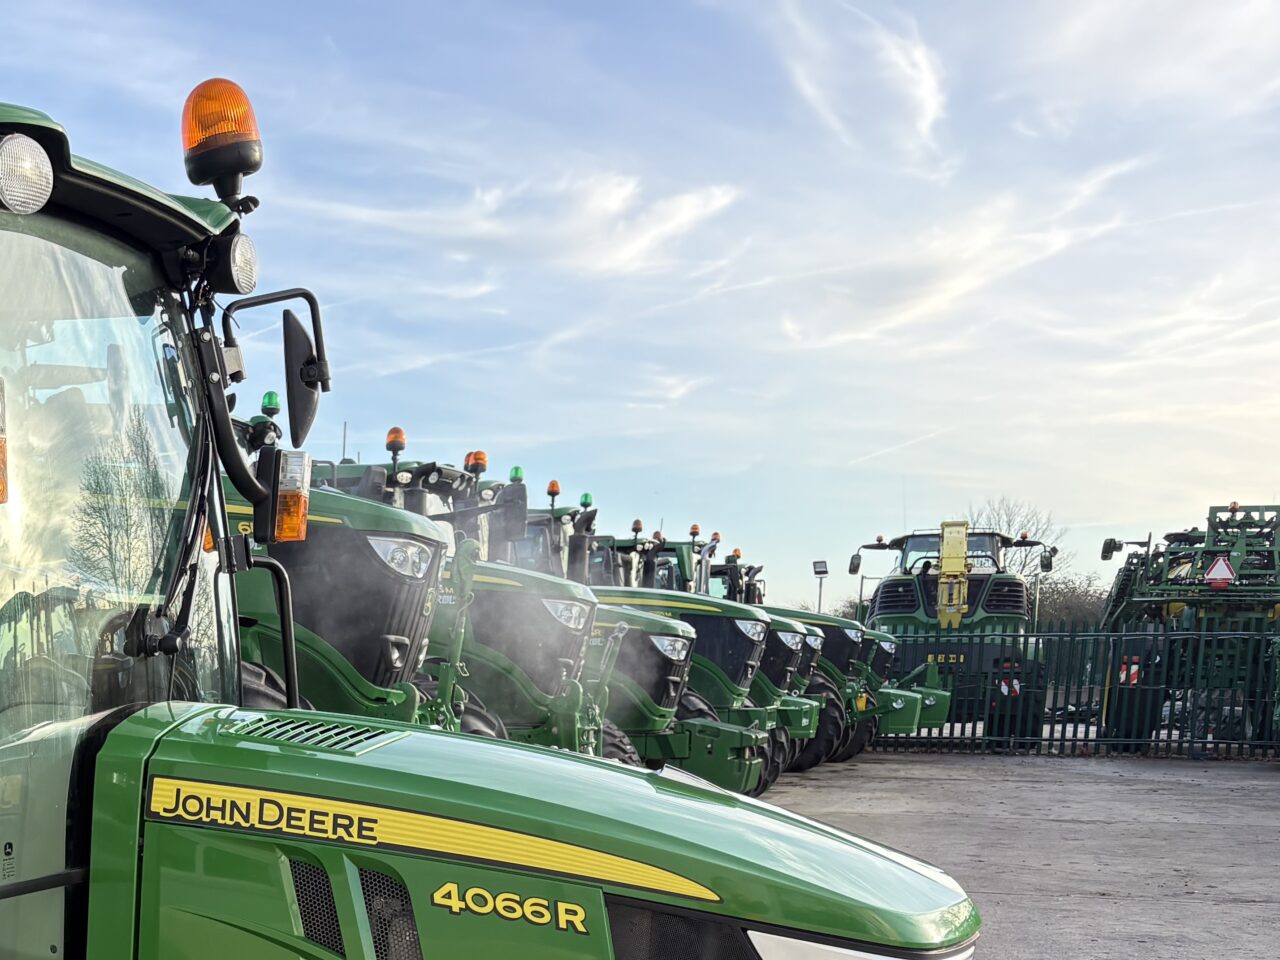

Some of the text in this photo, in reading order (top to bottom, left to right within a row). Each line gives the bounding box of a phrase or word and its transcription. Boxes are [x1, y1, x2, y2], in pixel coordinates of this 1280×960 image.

[162, 788, 379, 842] JOHN DEERE
[431, 881, 590, 936] 4066 R
